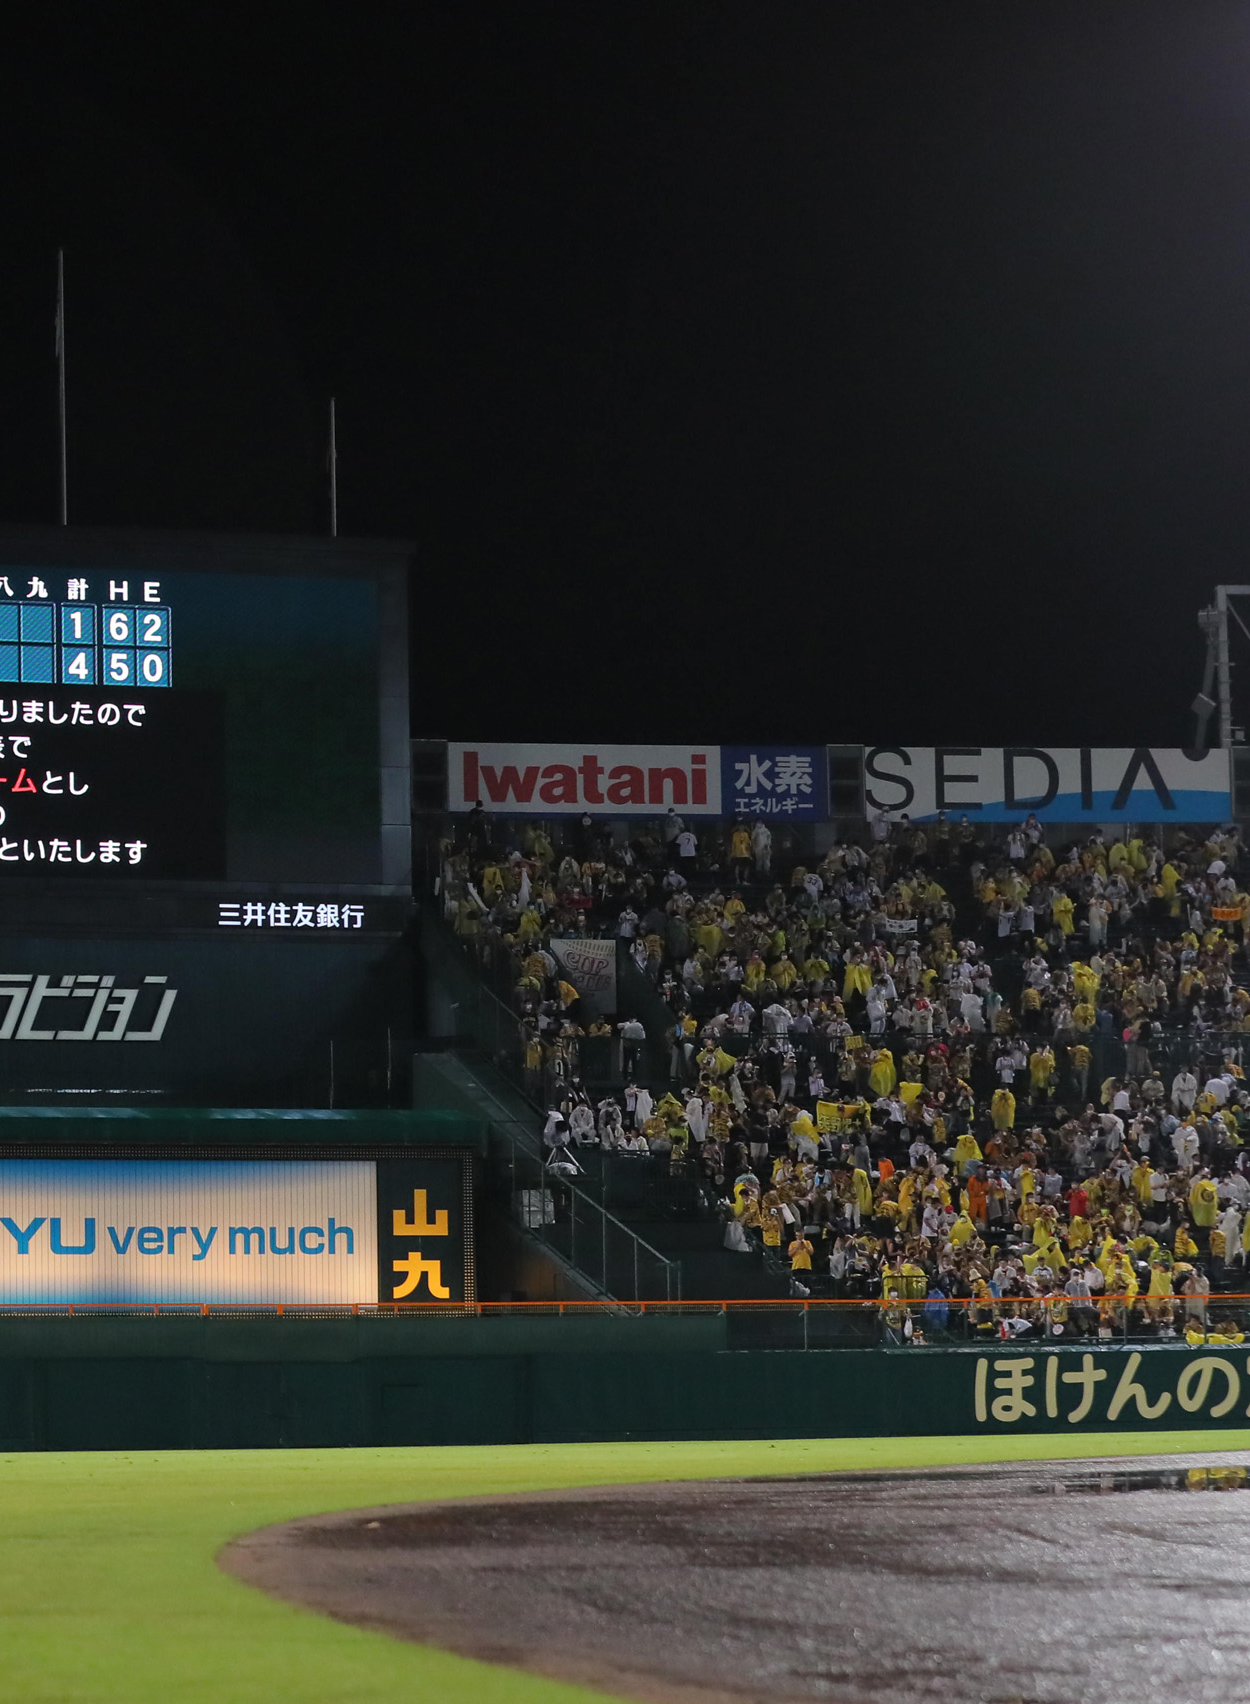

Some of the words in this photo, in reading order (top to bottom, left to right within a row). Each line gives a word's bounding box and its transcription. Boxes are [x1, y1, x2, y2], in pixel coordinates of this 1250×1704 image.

[27, 578, 48, 597] 九
[68, 579, 88, 600] 計
[110, 581, 128, 600] H
[144, 582, 160, 602] E
[71, 612, 81, 638] 1
[110, 613, 128, 640] 6
[144, 614, 161, 641] 2
[69, 652, 88, 679] 4
[110, 653, 128, 680] 5
[143, 654, 162, 682] 0
[463, 751, 707, 805] Iwatani
[735, 755, 812, 794] 水素
[865, 747, 1177, 811] SEDIA
[735, 797, 813, 813] エネルギー
[219, 903, 364, 927] 三井住友銀行
[108, 1227, 216, 1260] very
[230, 1218, 353, 1254] much
[393, 1190, 450, 1299] 山九
[974, 1352, 1250, 1424] ほけんの
